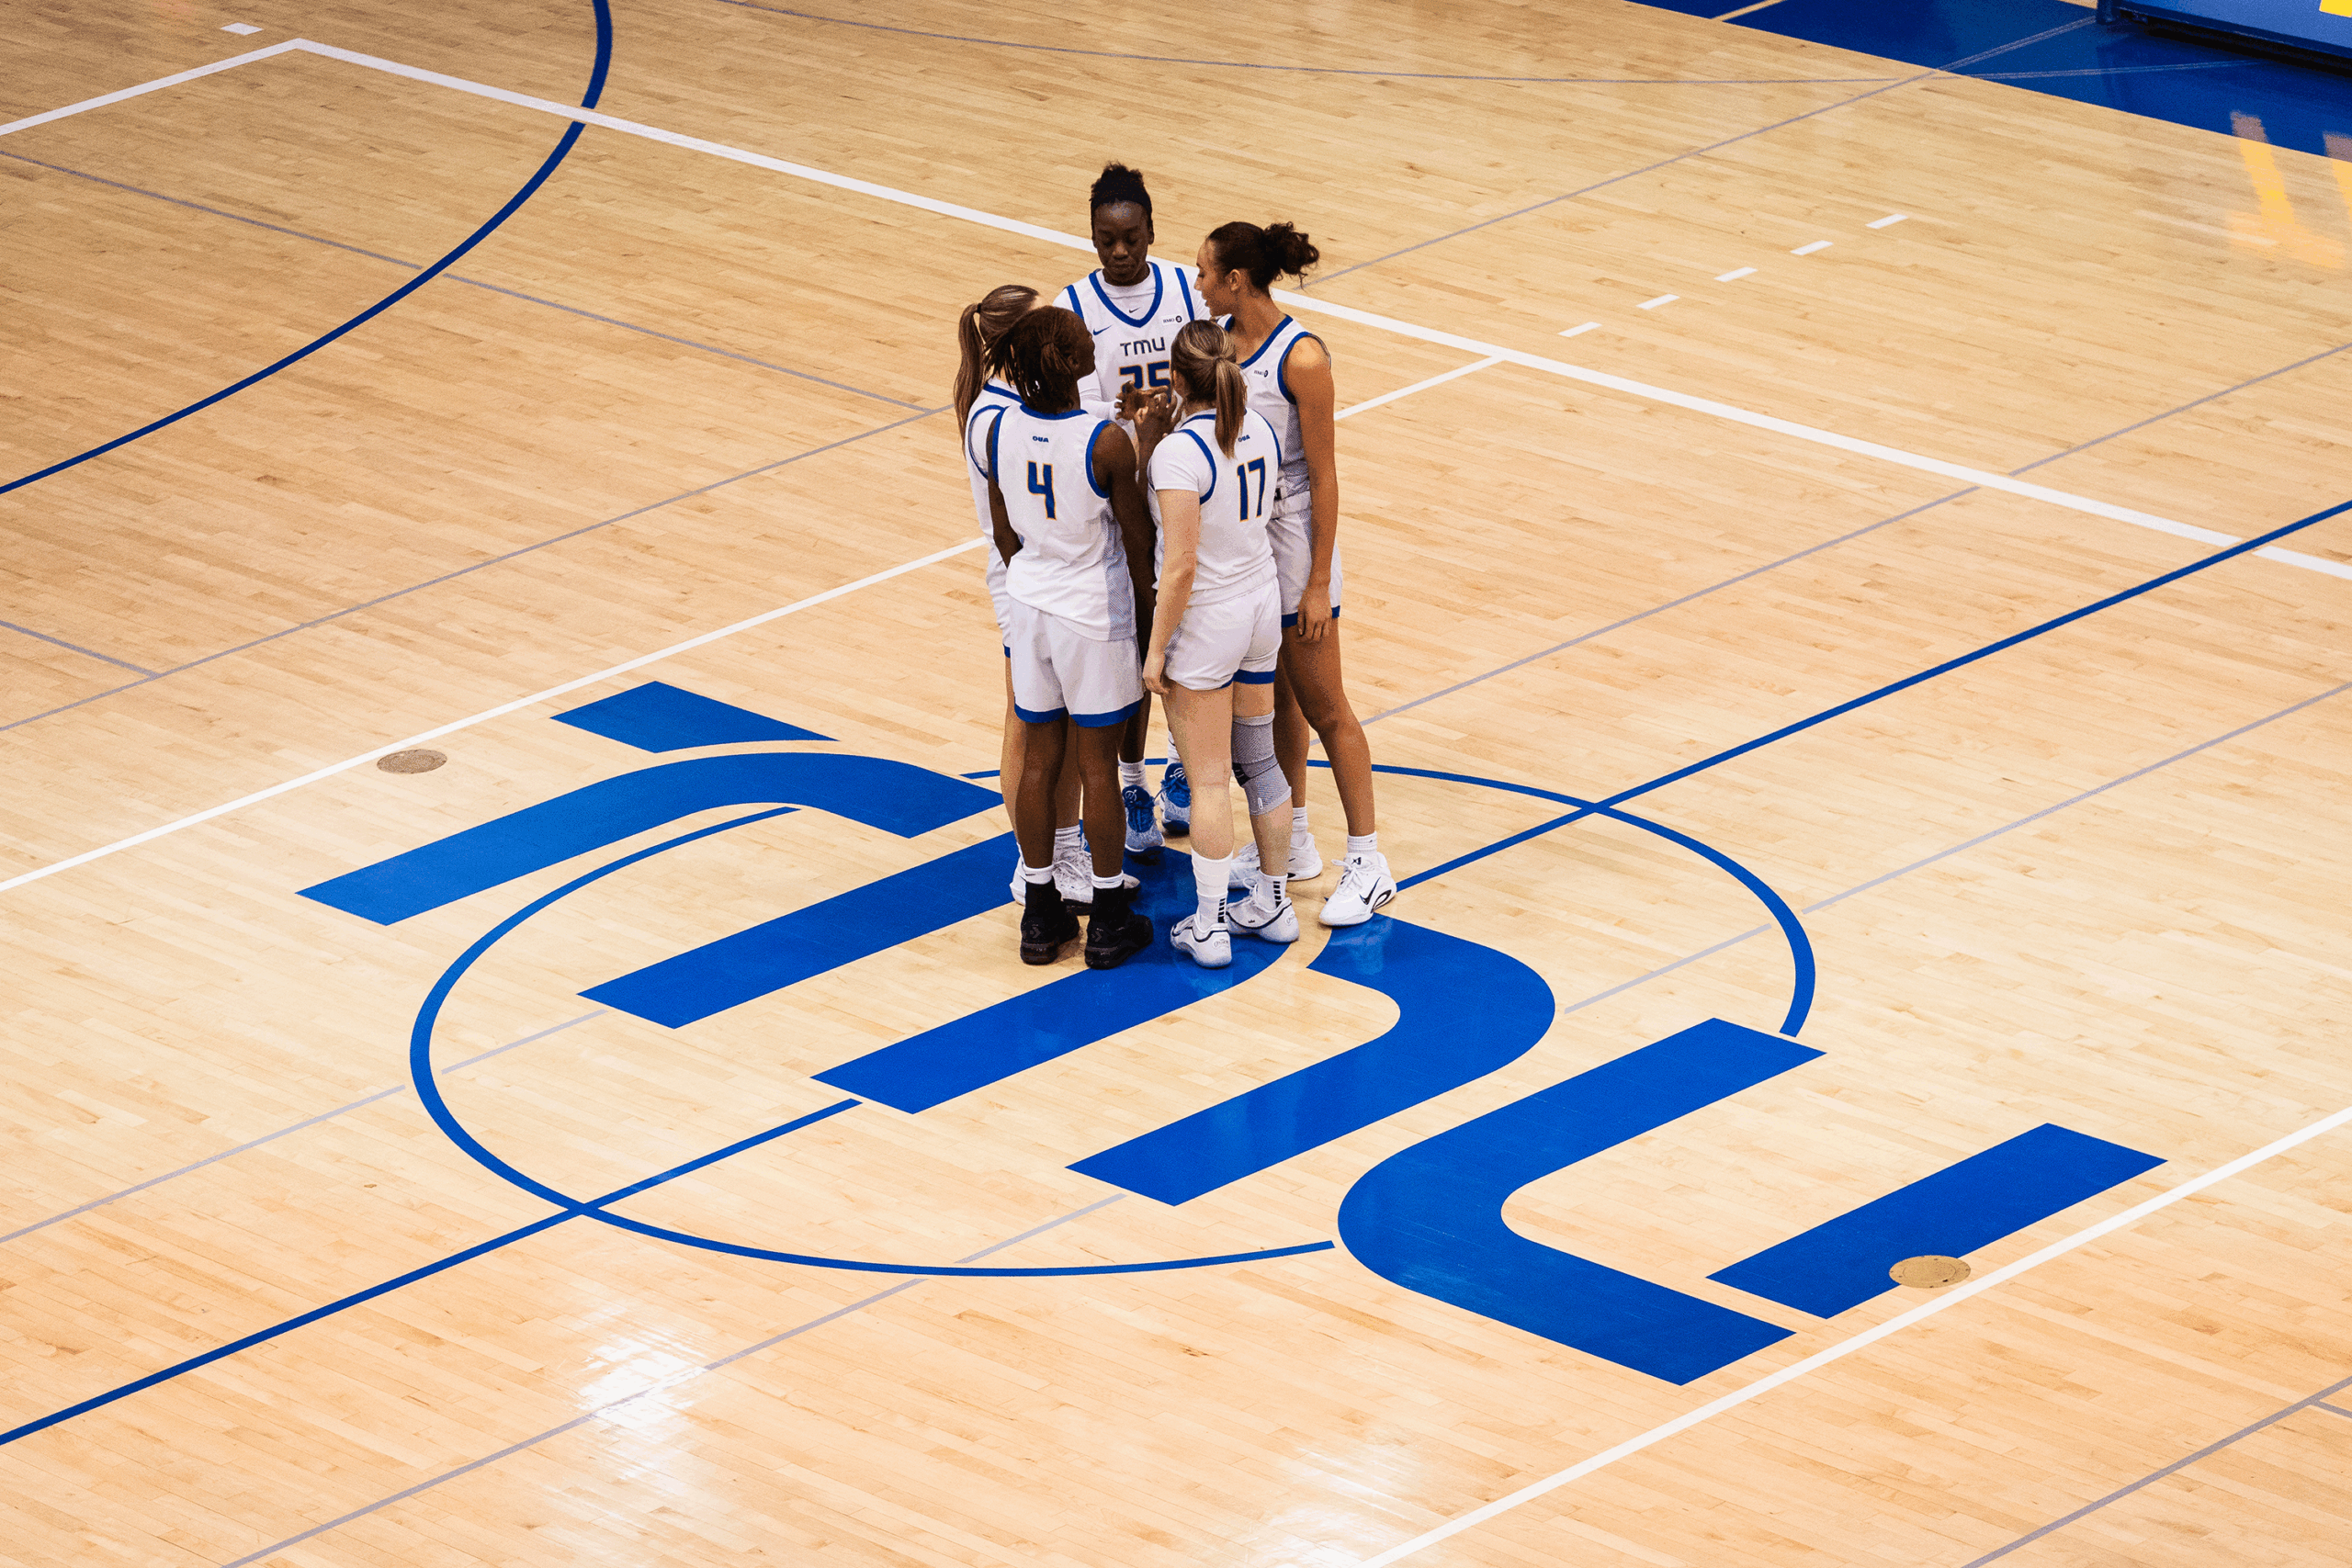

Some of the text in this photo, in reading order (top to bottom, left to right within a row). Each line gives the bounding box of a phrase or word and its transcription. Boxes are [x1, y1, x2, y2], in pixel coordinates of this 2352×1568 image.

[1119, 336, 1166, 356] TMU
[1118, 359, 1171, 401] 25
[1026, 460, 1057, 521] 4
[1237, 456, 1266, 523] 17
